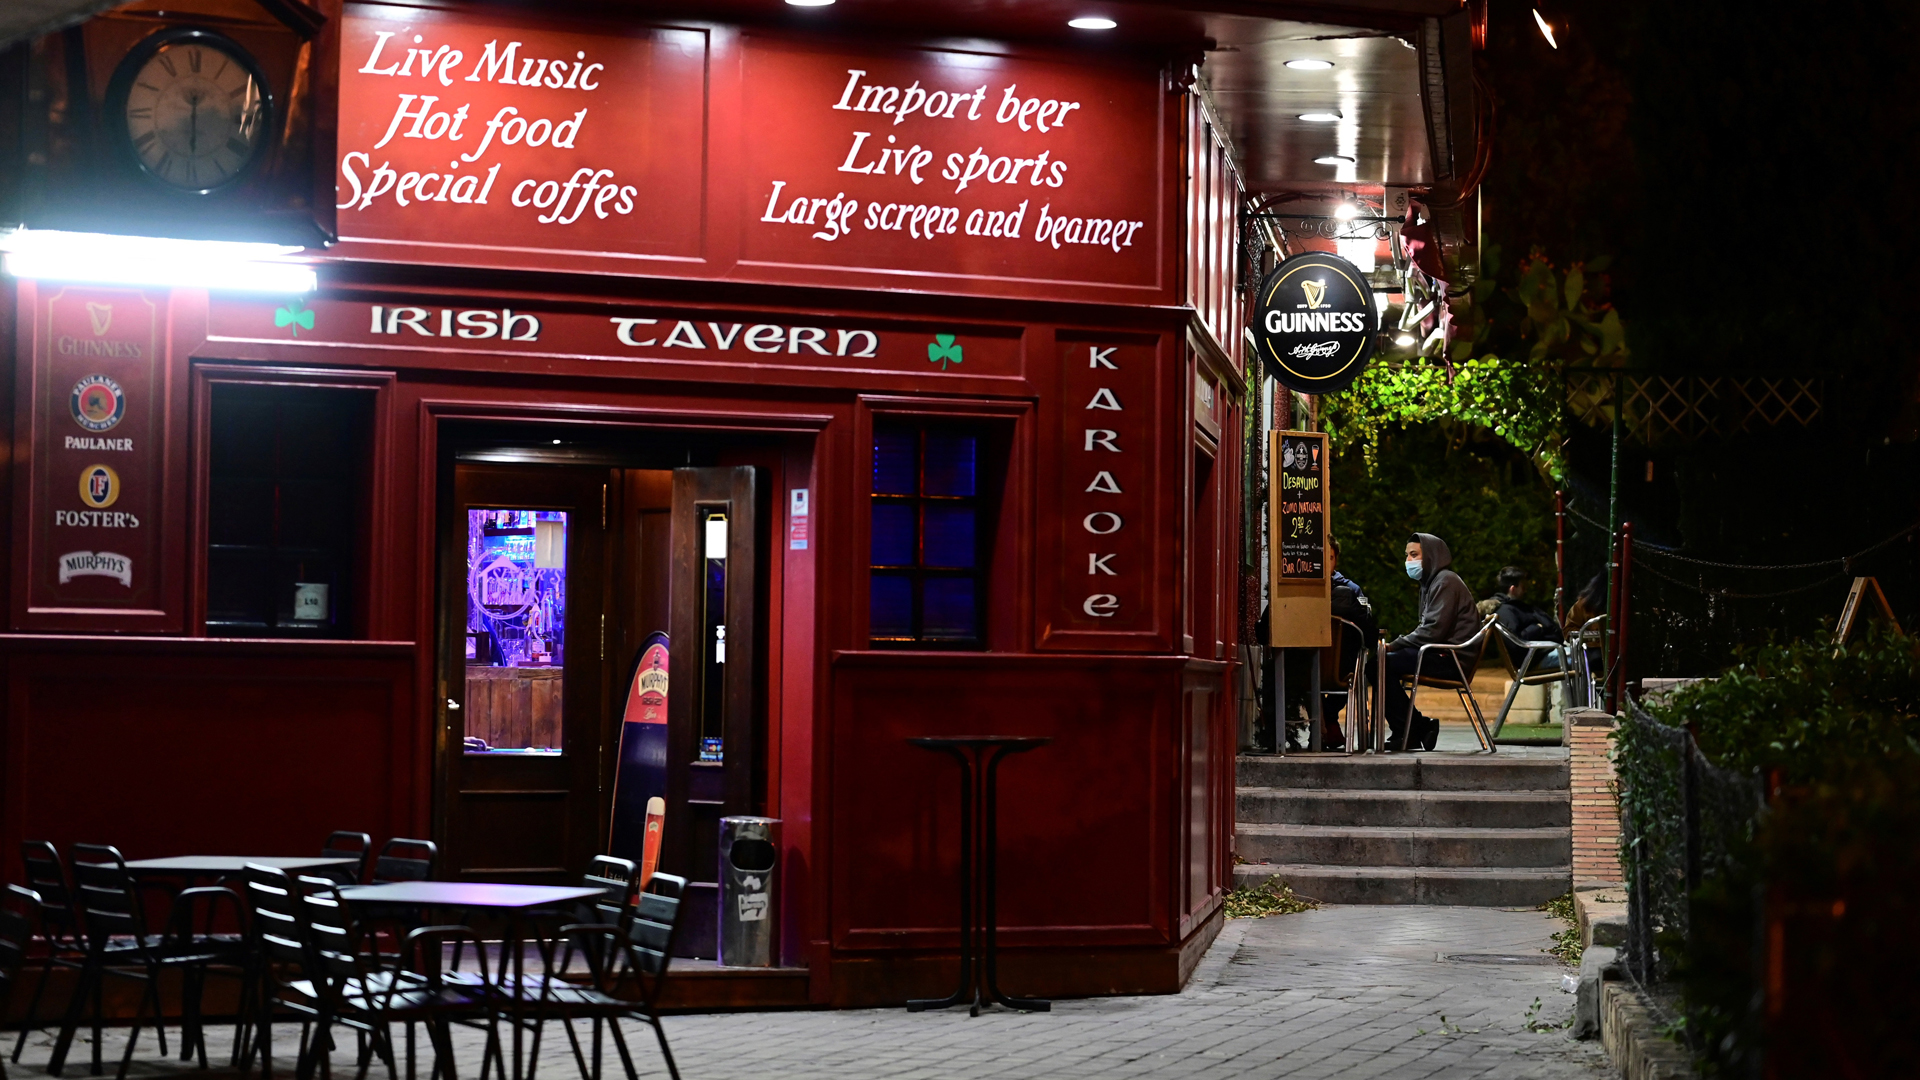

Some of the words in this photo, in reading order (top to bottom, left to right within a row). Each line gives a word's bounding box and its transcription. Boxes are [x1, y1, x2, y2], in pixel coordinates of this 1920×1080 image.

[357, 31, 463, 87] Live
[465, 39, 604, 91] Music
[374, 93, 471, 150] Hot
[461, 107, 588, 163] food
[832, 69, 987, 126] Import
[997, 83, 1081, 134] beer
[336, 151, 501, 212] Special
[511, 167, 638, 225] coffes
[838, 131, 933, 185] Live
[942, 146, 1068, 195] sports
[760, 180, 858, 242] Large
[864, 202, 960, 240] screen
[965, 199, 1029, 239] and
[1034, 203, 1144, 253] beamer
[58, 334, 142, 359] GUINNESS
[1265, 310, 1366, 334] GUINNESS
[64, 436, 133, 452] PAULANER
[92, 475, 108, 496] F
[55, 510, 140, 528] FOSTER'S
